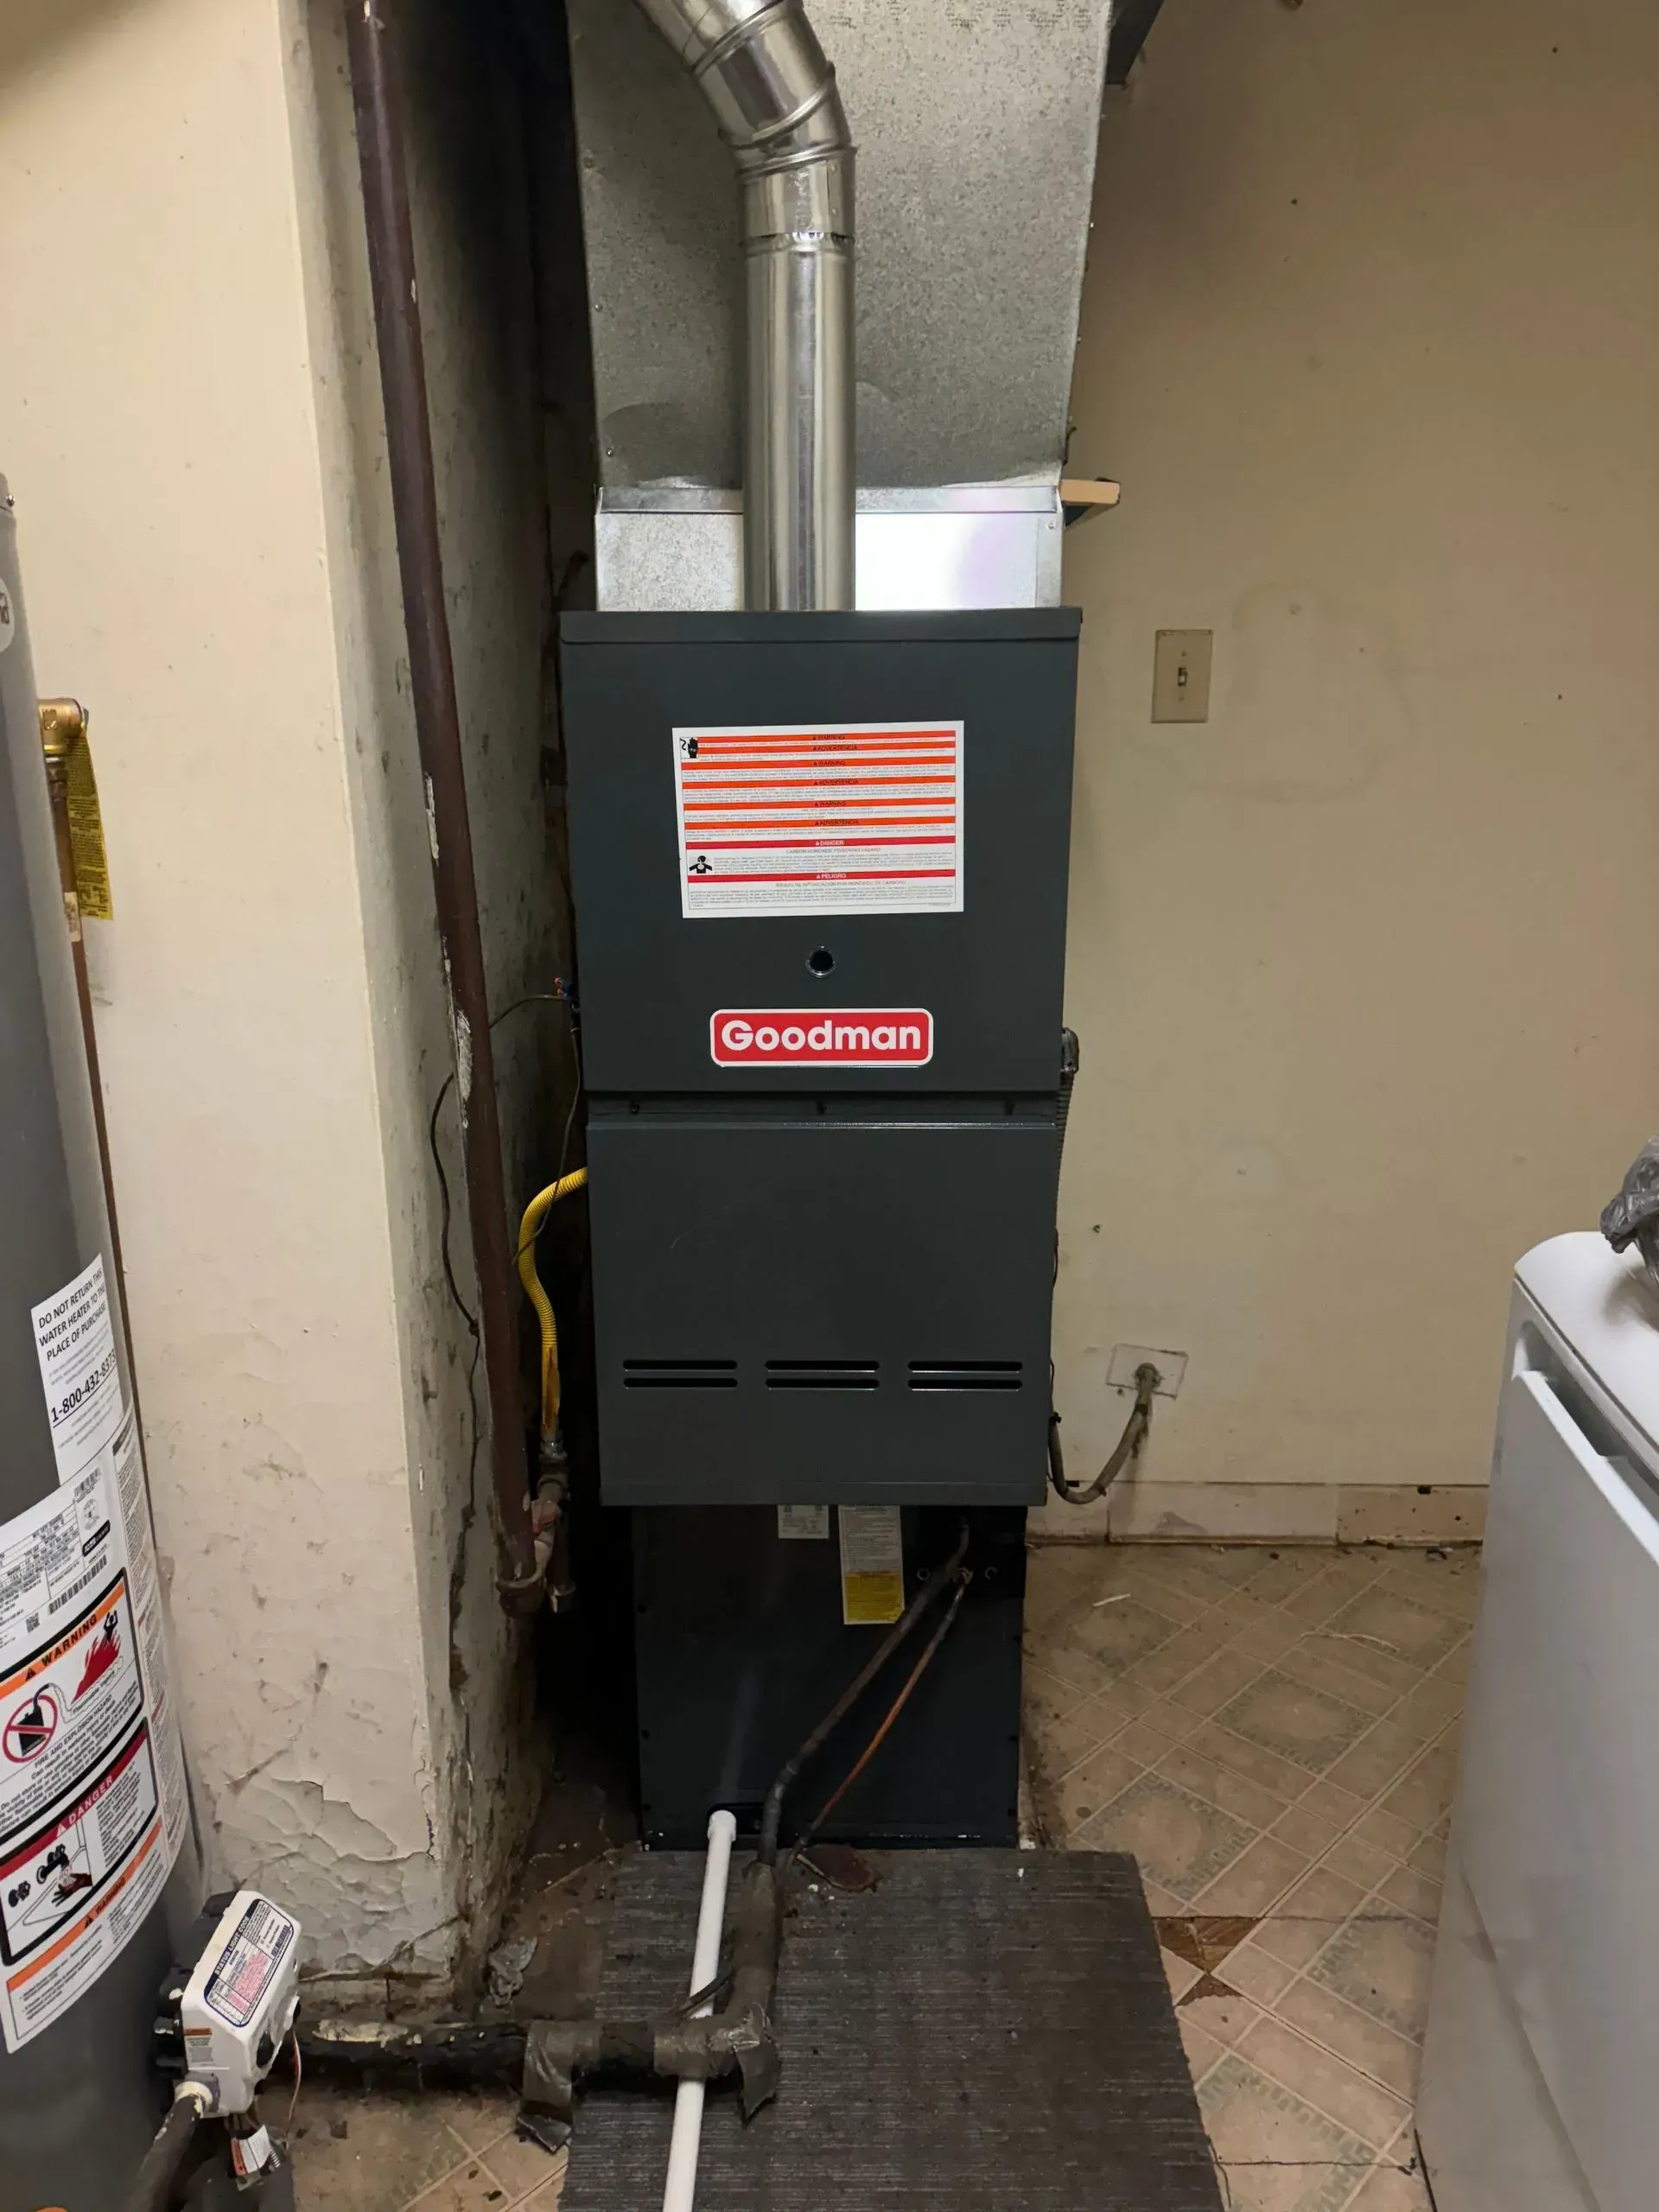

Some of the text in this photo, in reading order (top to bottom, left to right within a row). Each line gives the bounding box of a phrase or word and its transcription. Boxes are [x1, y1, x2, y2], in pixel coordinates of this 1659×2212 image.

[721, 1020, 921, 1051] Goodman
[38, 1268, 103, 1328] DO NOT RETURN THIS
[39, 1285, 105, 1346] WATER HEATER TO THE
[47, 1303, 106, 1361] PLACE OF PURCHASE
[51, 1349, 116, 1423] 1-800-432-8373
[41, 1614, 98, 1667] WARNING
[34, 1752, 48, 1769] FIRE
[49, 1741, 63, 1756] AND
[63, 1713, 93, 1745] EXPLOSION
[93, 1693, 111, 1716] HAZARD
[30, 1765, 43, 1781] Can
[44, 1752, 60, 1770] result
[1, 1801, 10, 1810] Do
[69, 1774, 114, 1826] DANGER
[95, 1877, 126, 1914] WARNING
[214, 1948, 230, 1976] STATUS
[227, 1929, 240, 1953] LIGHT
[238, 1913, 249, 1935] CODE
